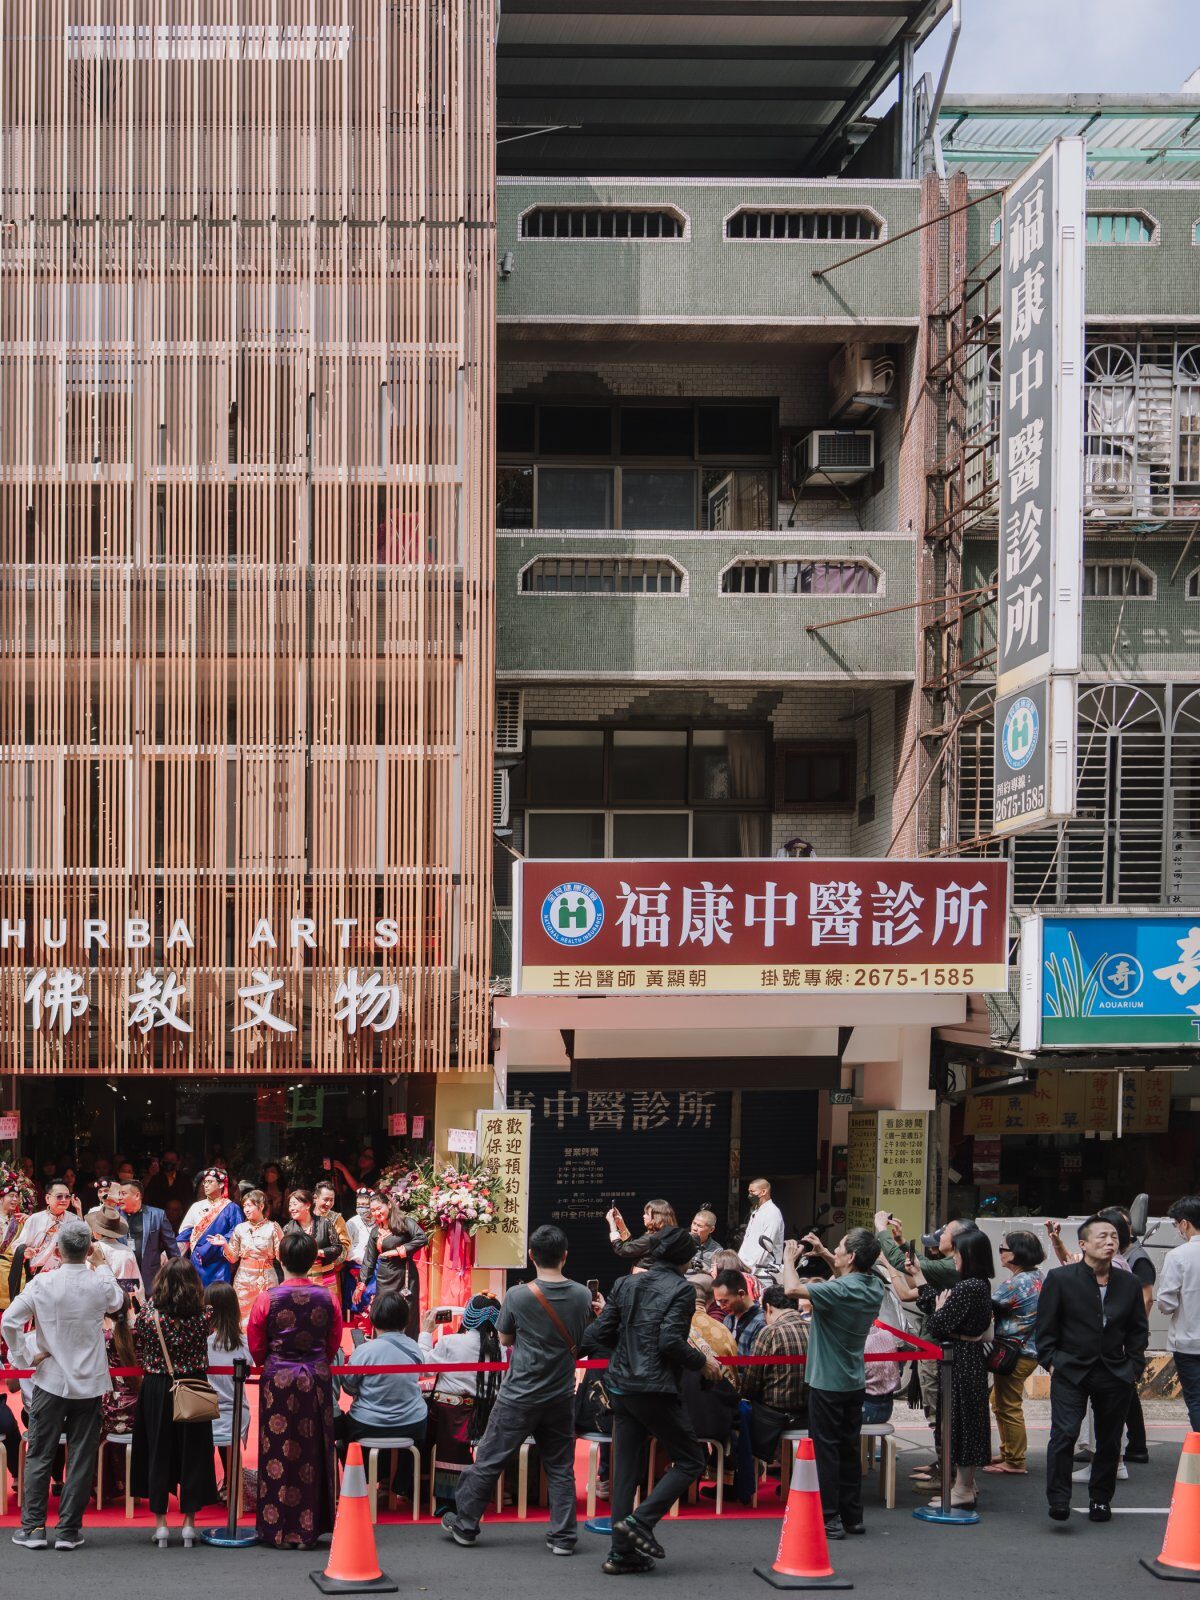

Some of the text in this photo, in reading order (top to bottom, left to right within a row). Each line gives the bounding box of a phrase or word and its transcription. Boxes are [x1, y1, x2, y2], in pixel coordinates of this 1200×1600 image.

[1004, 177, 1045, 661] 福康中醫診所
[996, 785, 1044, 821] 2675-1585
[616, 881, 988, 948] 福康中醫診所
[250, 918, 400, 949] ARTS
[553, 969, 636, 987] 主治醫師
[646, 969, 707, 987] 黃顯朝
[1108, 961, 1136, 991] 奇
[886, 1118, 923, 1128] 看診時間
[502, 1117, 523, 1235] 歡迎預約掛號
